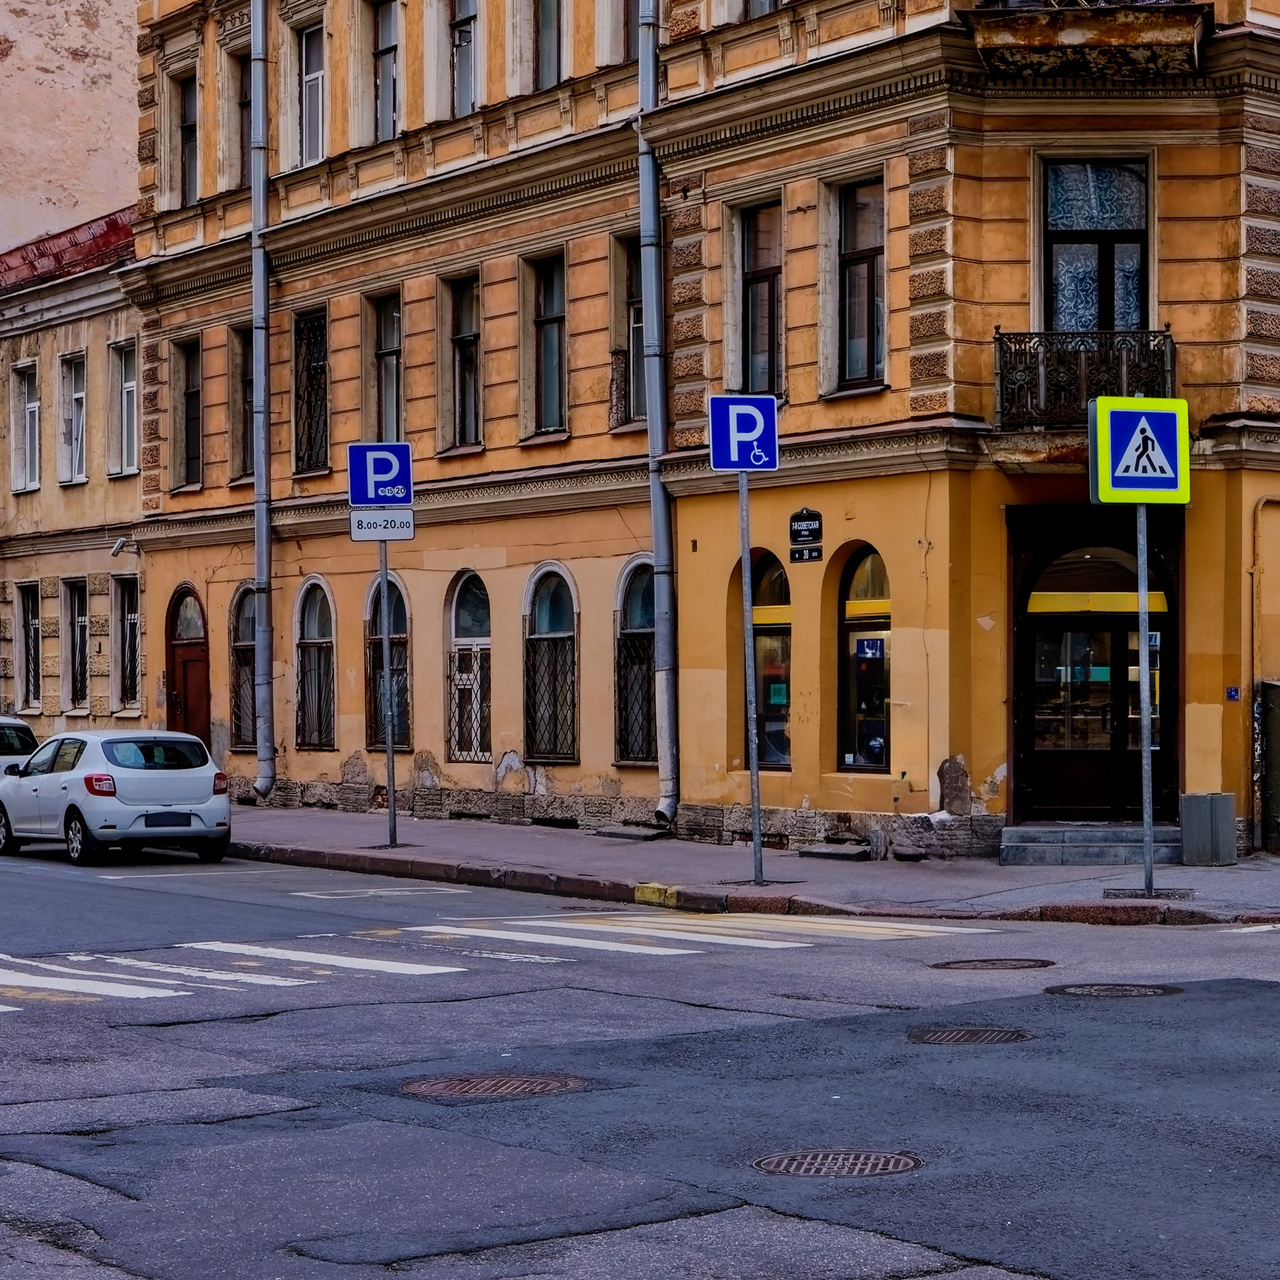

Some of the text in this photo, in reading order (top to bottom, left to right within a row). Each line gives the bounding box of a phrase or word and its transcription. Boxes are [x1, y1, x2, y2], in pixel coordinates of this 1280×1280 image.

[729, 405, 764, 461] P
[366, 451, 400, 498] P
[395, 487, 406, 495] 20
[356, 519, 411, 530] 8.00-20.00
